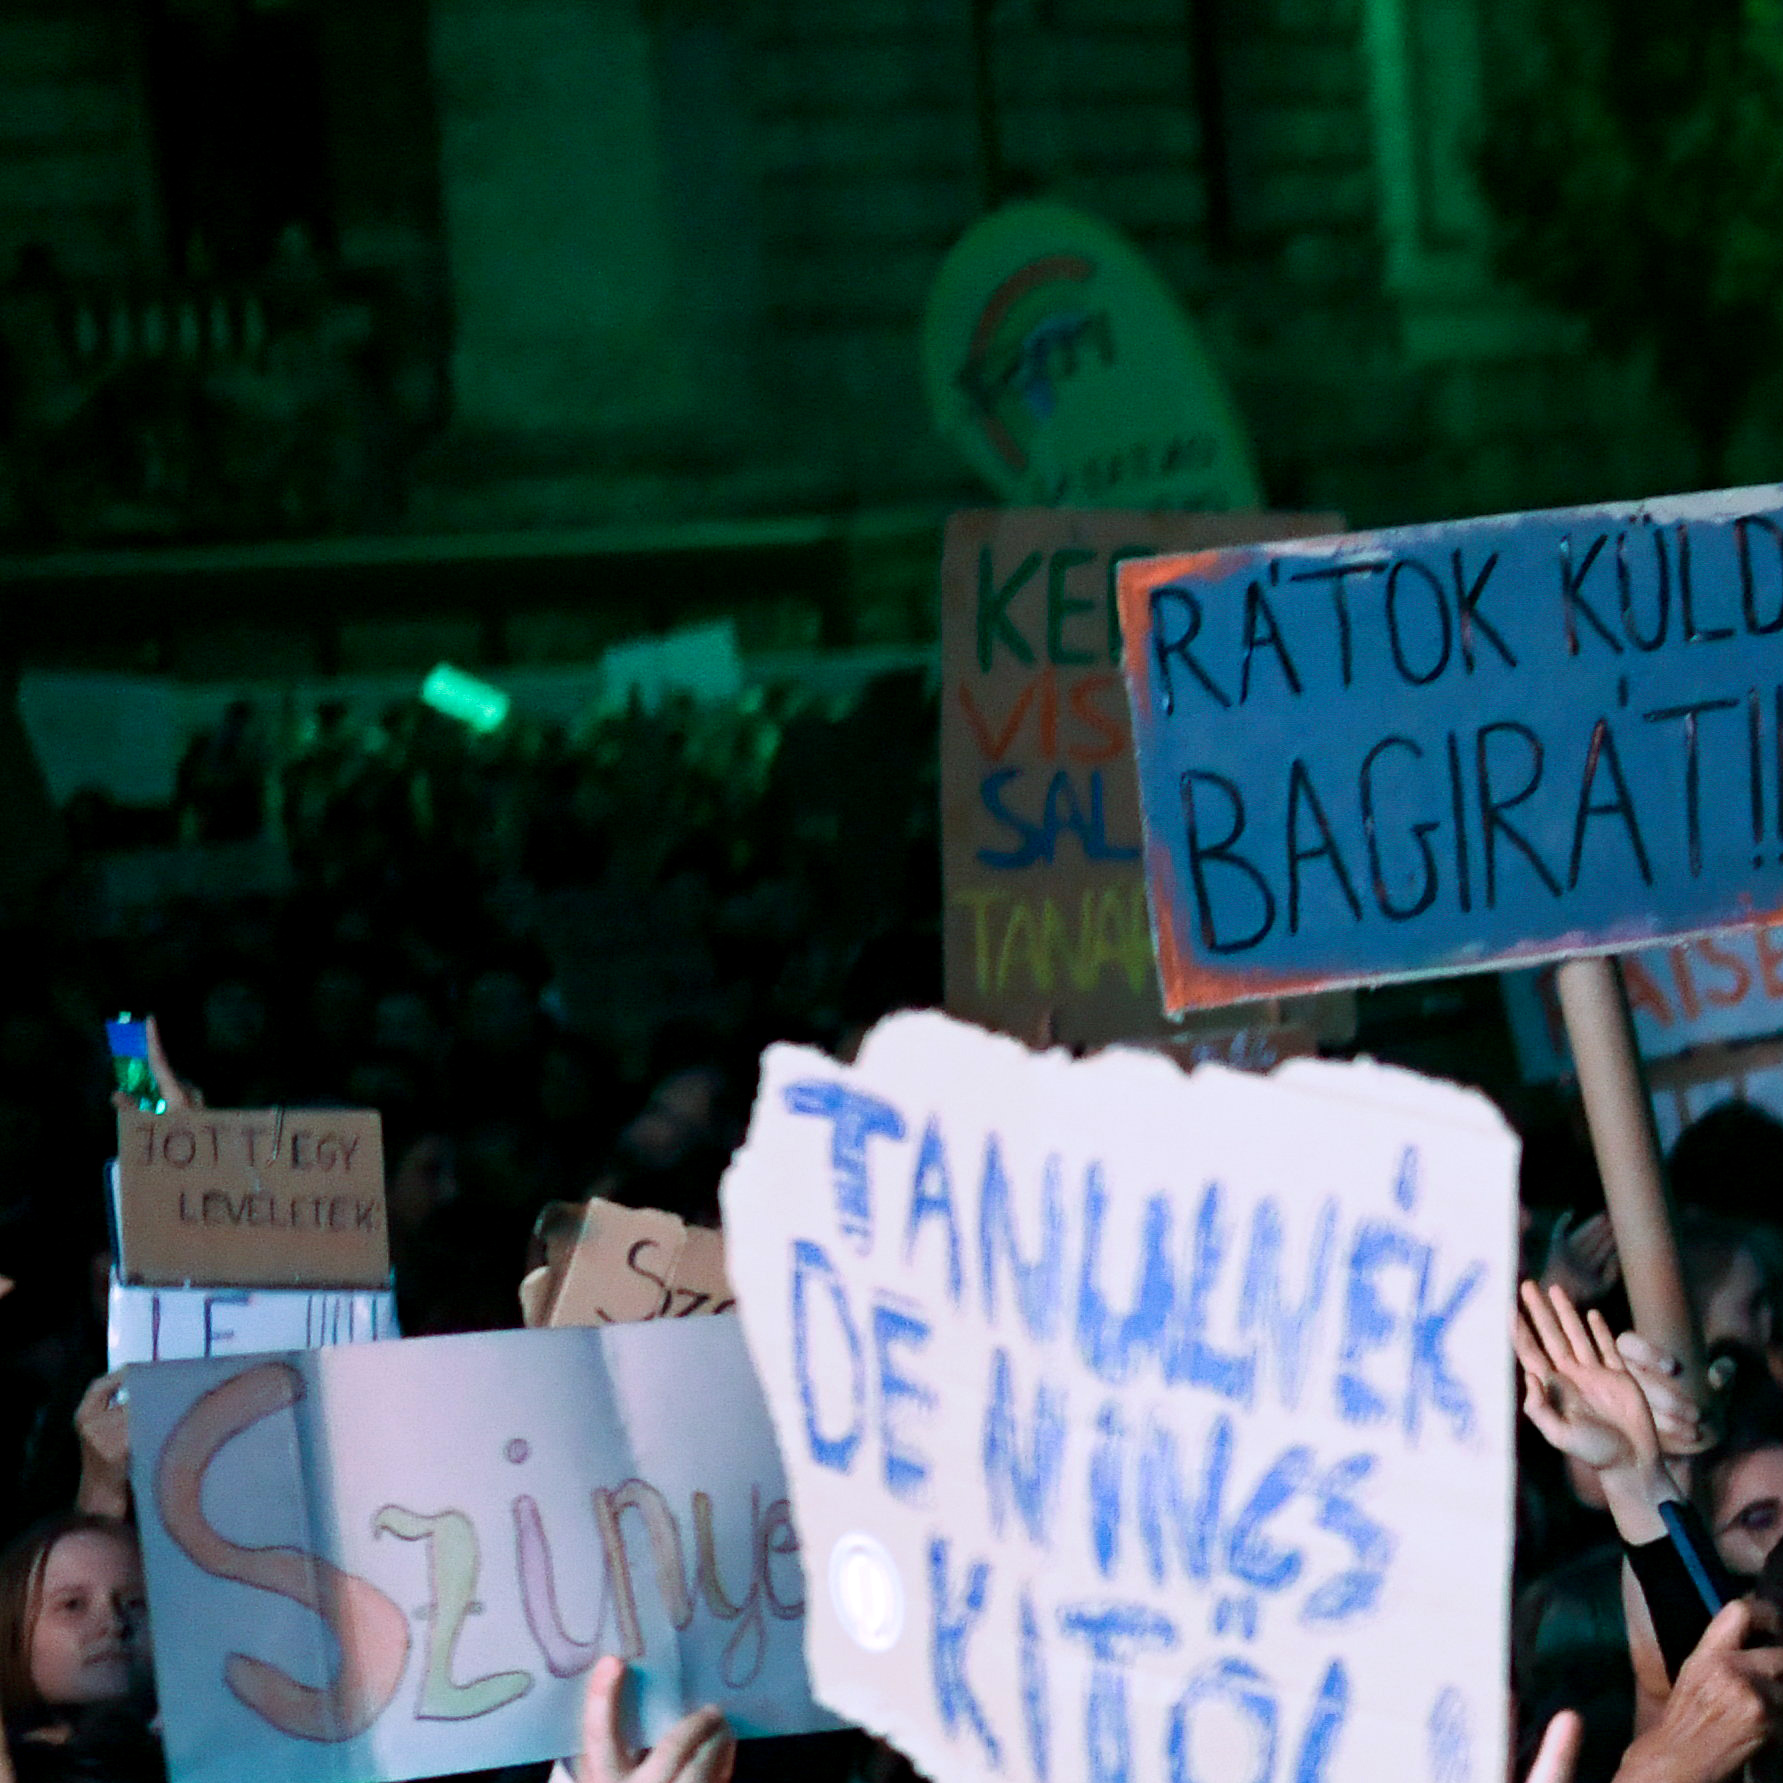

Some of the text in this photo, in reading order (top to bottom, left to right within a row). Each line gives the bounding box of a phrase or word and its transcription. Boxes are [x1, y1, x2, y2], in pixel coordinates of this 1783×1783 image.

[1148, 549, 1518, 716] RÁTOK
[291, 1131, 358, 1173] EGY
[790, 1238, 931, 1508] DE
